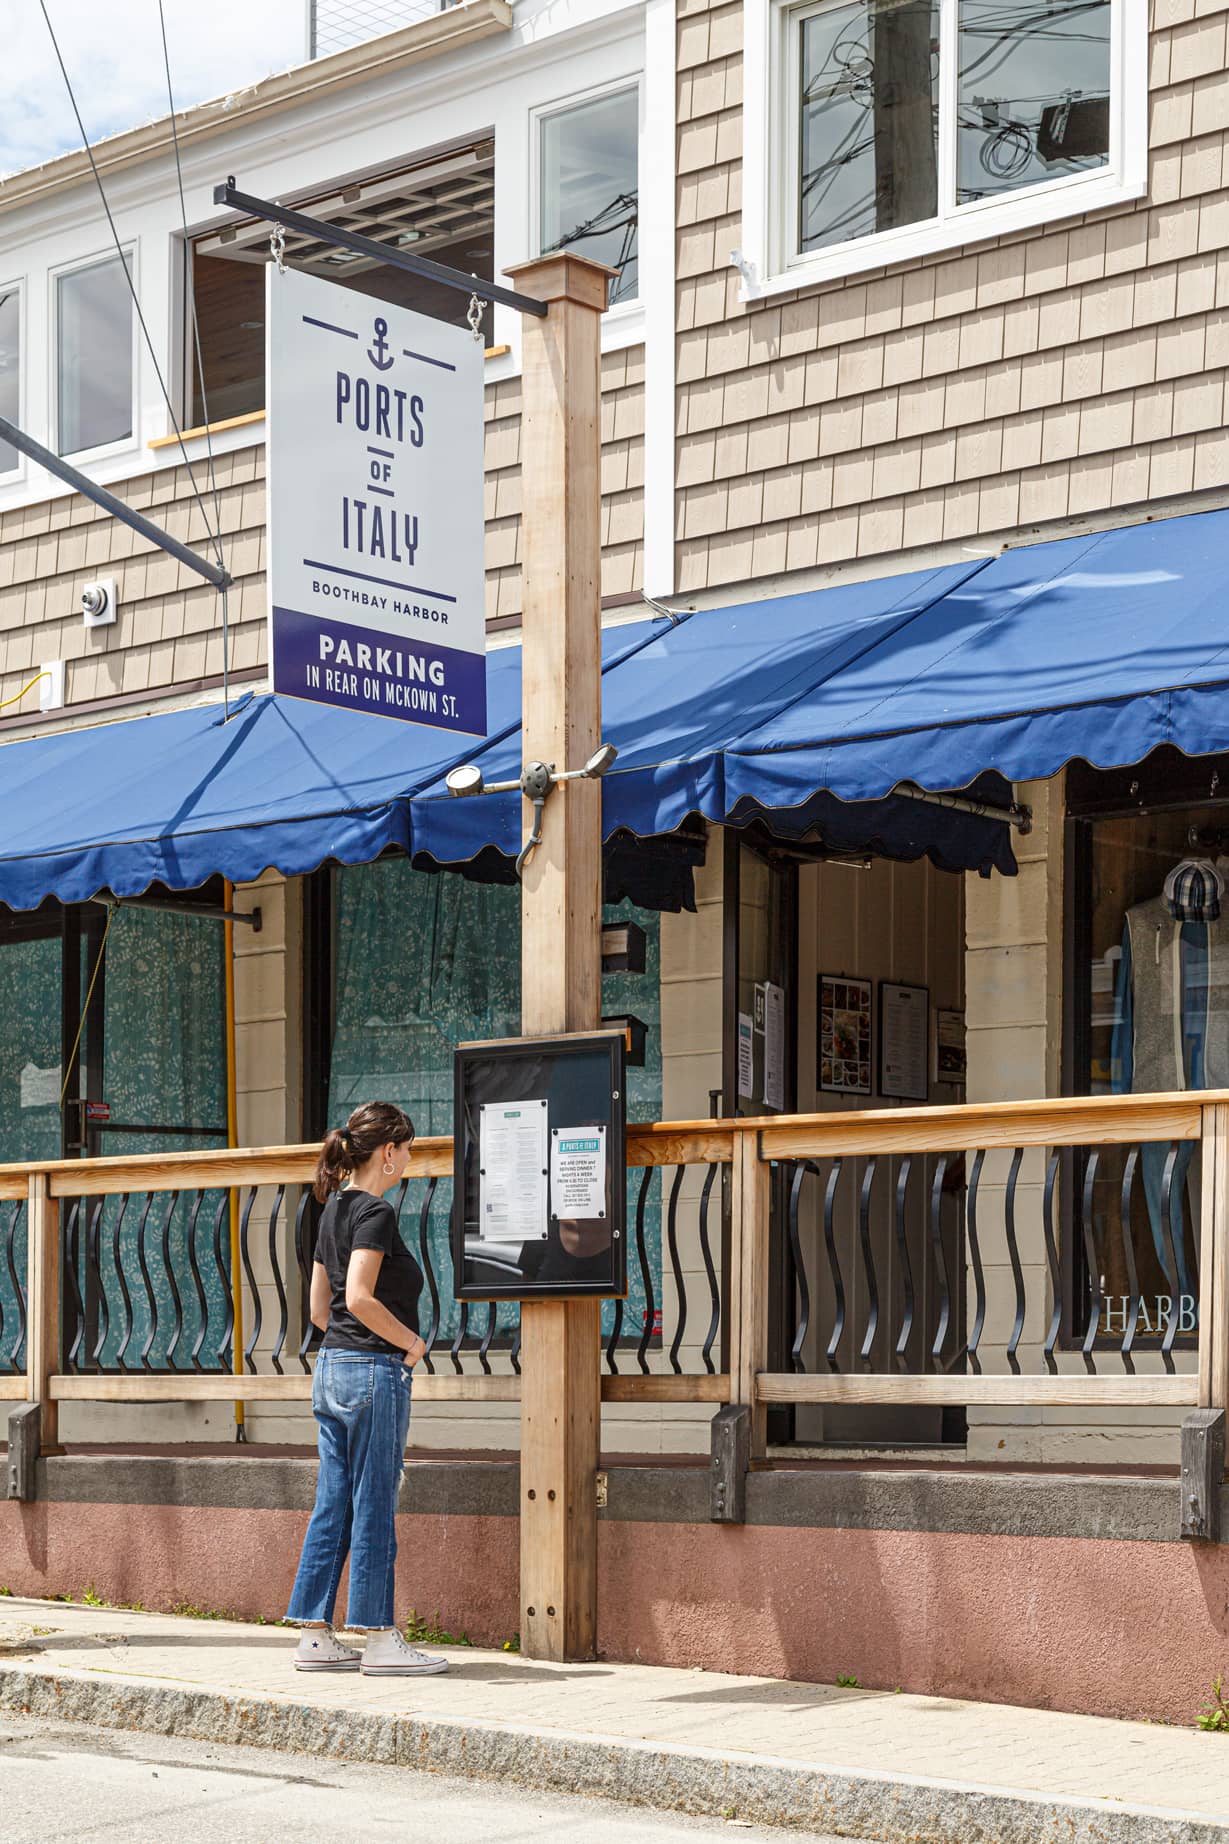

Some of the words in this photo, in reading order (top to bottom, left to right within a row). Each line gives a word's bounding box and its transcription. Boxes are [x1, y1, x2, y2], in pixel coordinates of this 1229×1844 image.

[336, 371, 424, 448] PORTS
[370, 460, 391, 482] OF
[343, 496, 418, 566] ITALY
[312, 580, 387, 609] BOOTHBAY
[393, 601, 449, 625] HARBOR
[319, 633, 445, 686] PARKING
[306, 664, 320, 688] IN
[325, 668, 358, 697] REAR
[363, 677, 380, 701] ON
[385, 681, 437, 713] MCKOWN
[442, 694, 459, 718] ST.
[1103, 1294, 1200, 1332] HARB
